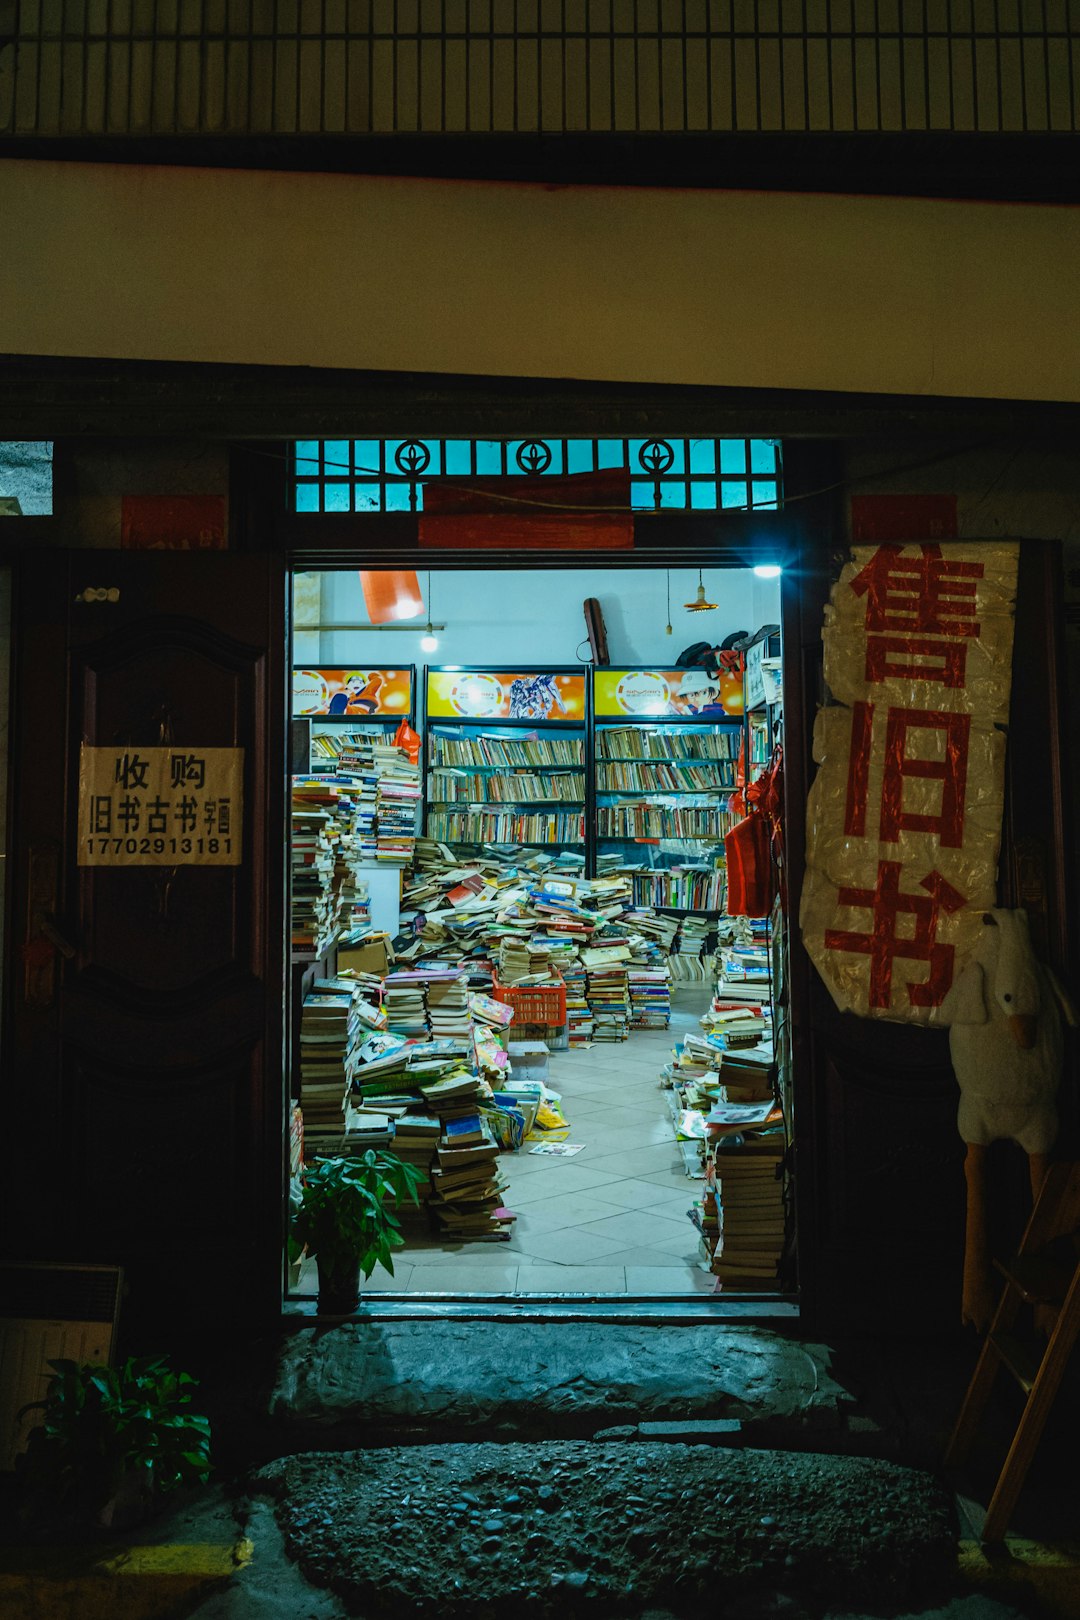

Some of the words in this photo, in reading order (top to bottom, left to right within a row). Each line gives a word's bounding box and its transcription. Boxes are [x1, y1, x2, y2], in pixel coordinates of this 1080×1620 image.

[115, 753, 206, 790] 收购
[824, 543, 985, 1009] 售旧书
[87, 838, 232, 854] 17702913181
